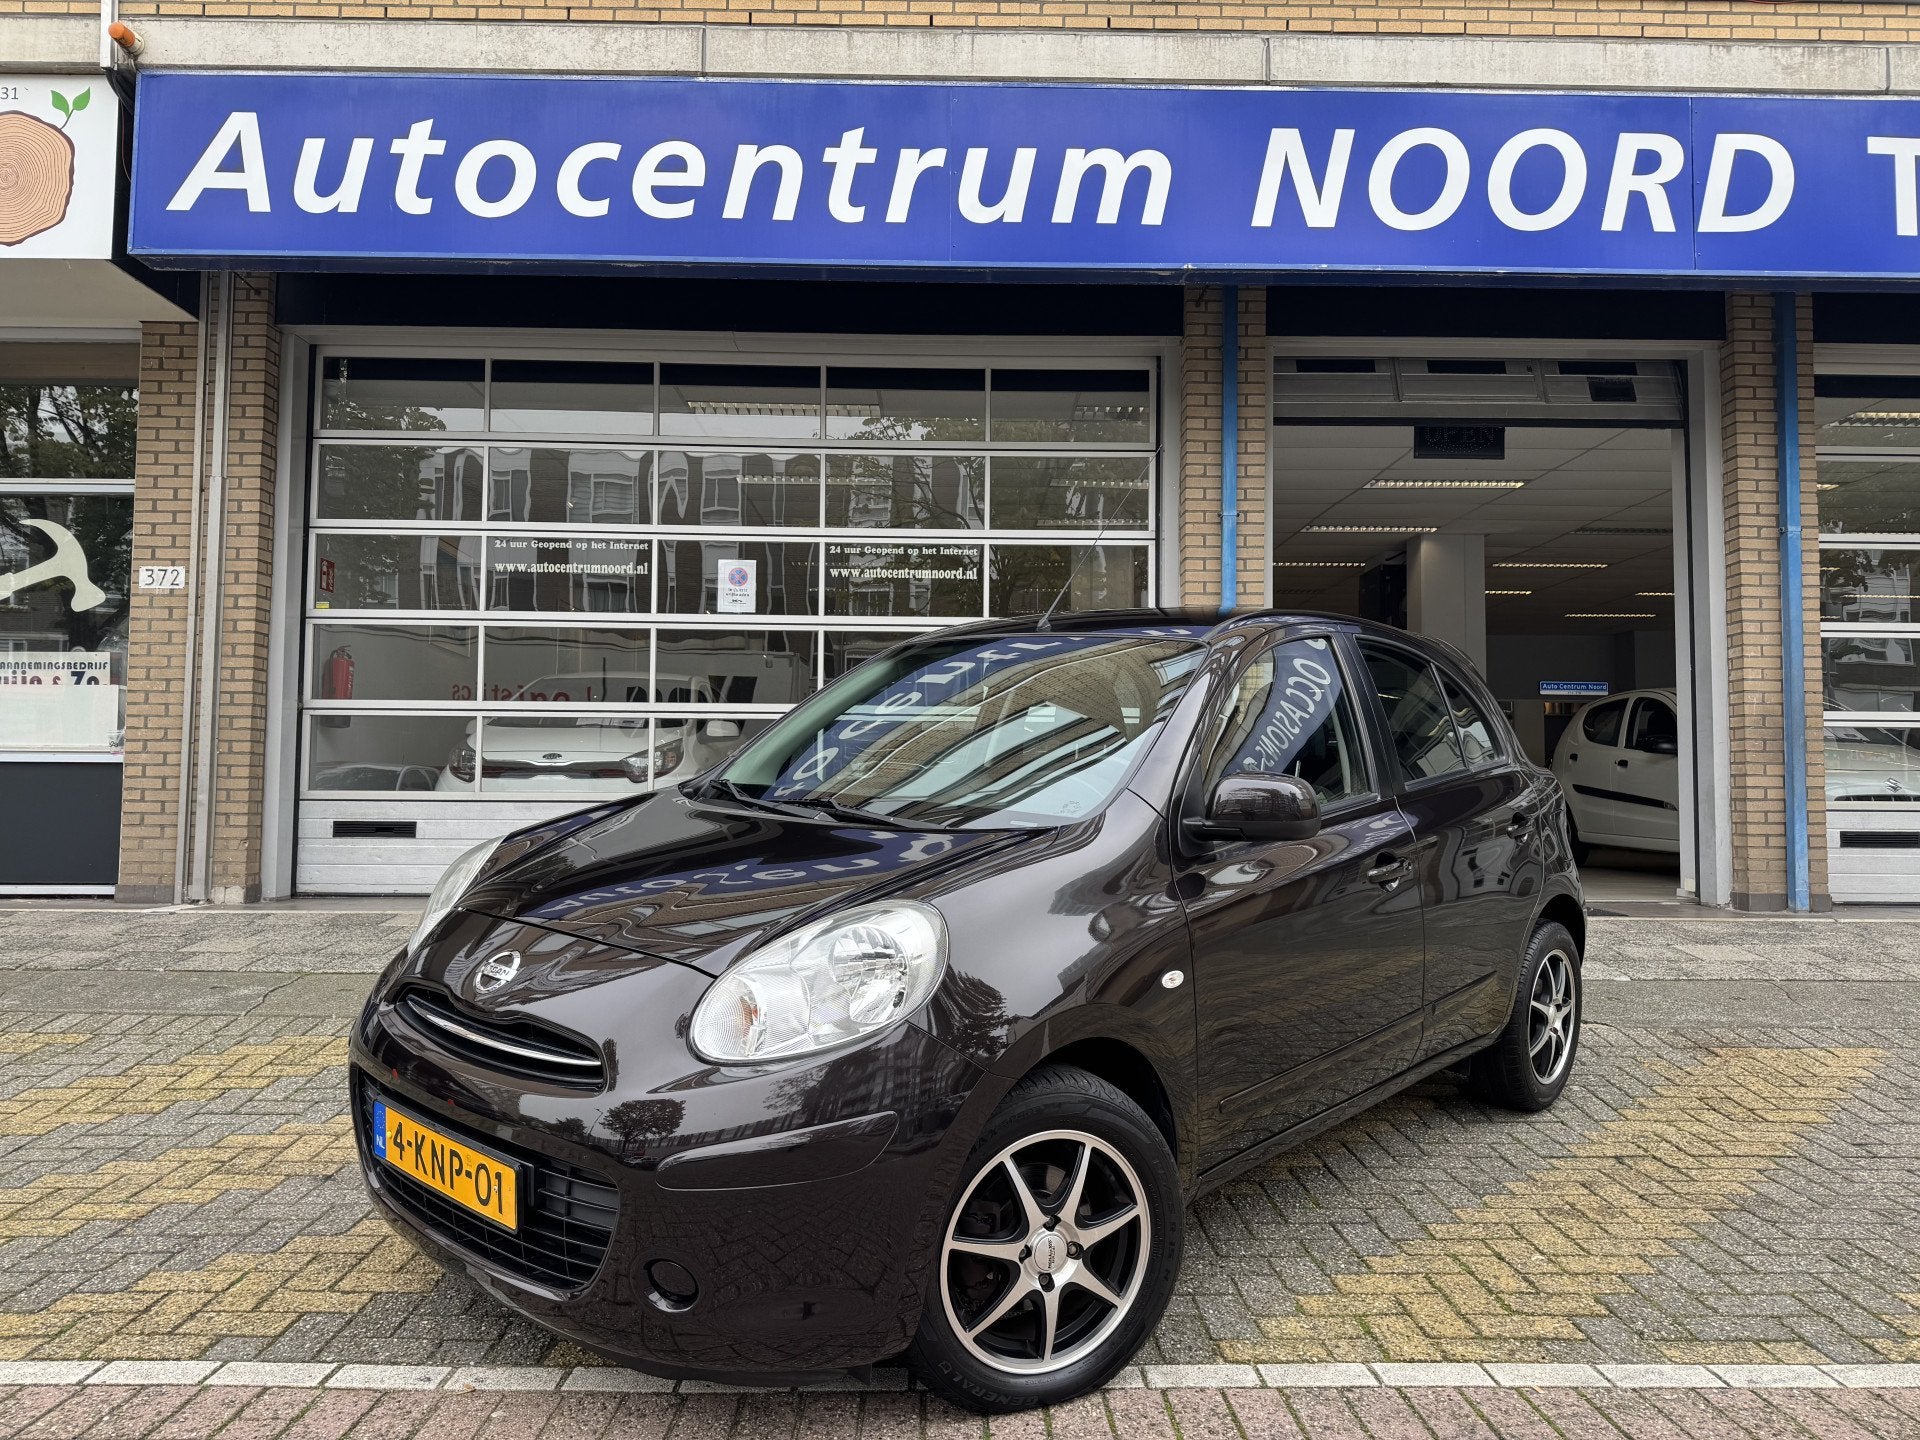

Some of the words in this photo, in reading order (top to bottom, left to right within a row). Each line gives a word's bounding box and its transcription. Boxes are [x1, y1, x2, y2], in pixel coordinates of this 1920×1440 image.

[166, 112, 1171, 225] Autocentrum
[1251, 128, 1794, 232] NOORD
[495, 540, 506, 548] 24
[531, 540, 572, 550] Geopend
[576, 542, 587, 550] op
[591, 541, 606, 549] het
[609, 541, 648, 549] Internet
[830, 546, 841, 554] 24
[865, 546, 904, 555] Geopend
[908, 547, 919, 556] op
[940, 547, 978, 555] Internet
[495, 562, 648, 575] www.autocentrumnoord.nl
[829, 568, 977, 579] www.autocentrumnoord.nl
[145, 568, 180, 586] 372
[376, 1134, 385, 1149] NL
[393, 1121, 503, 1215] 4-KNP-01
